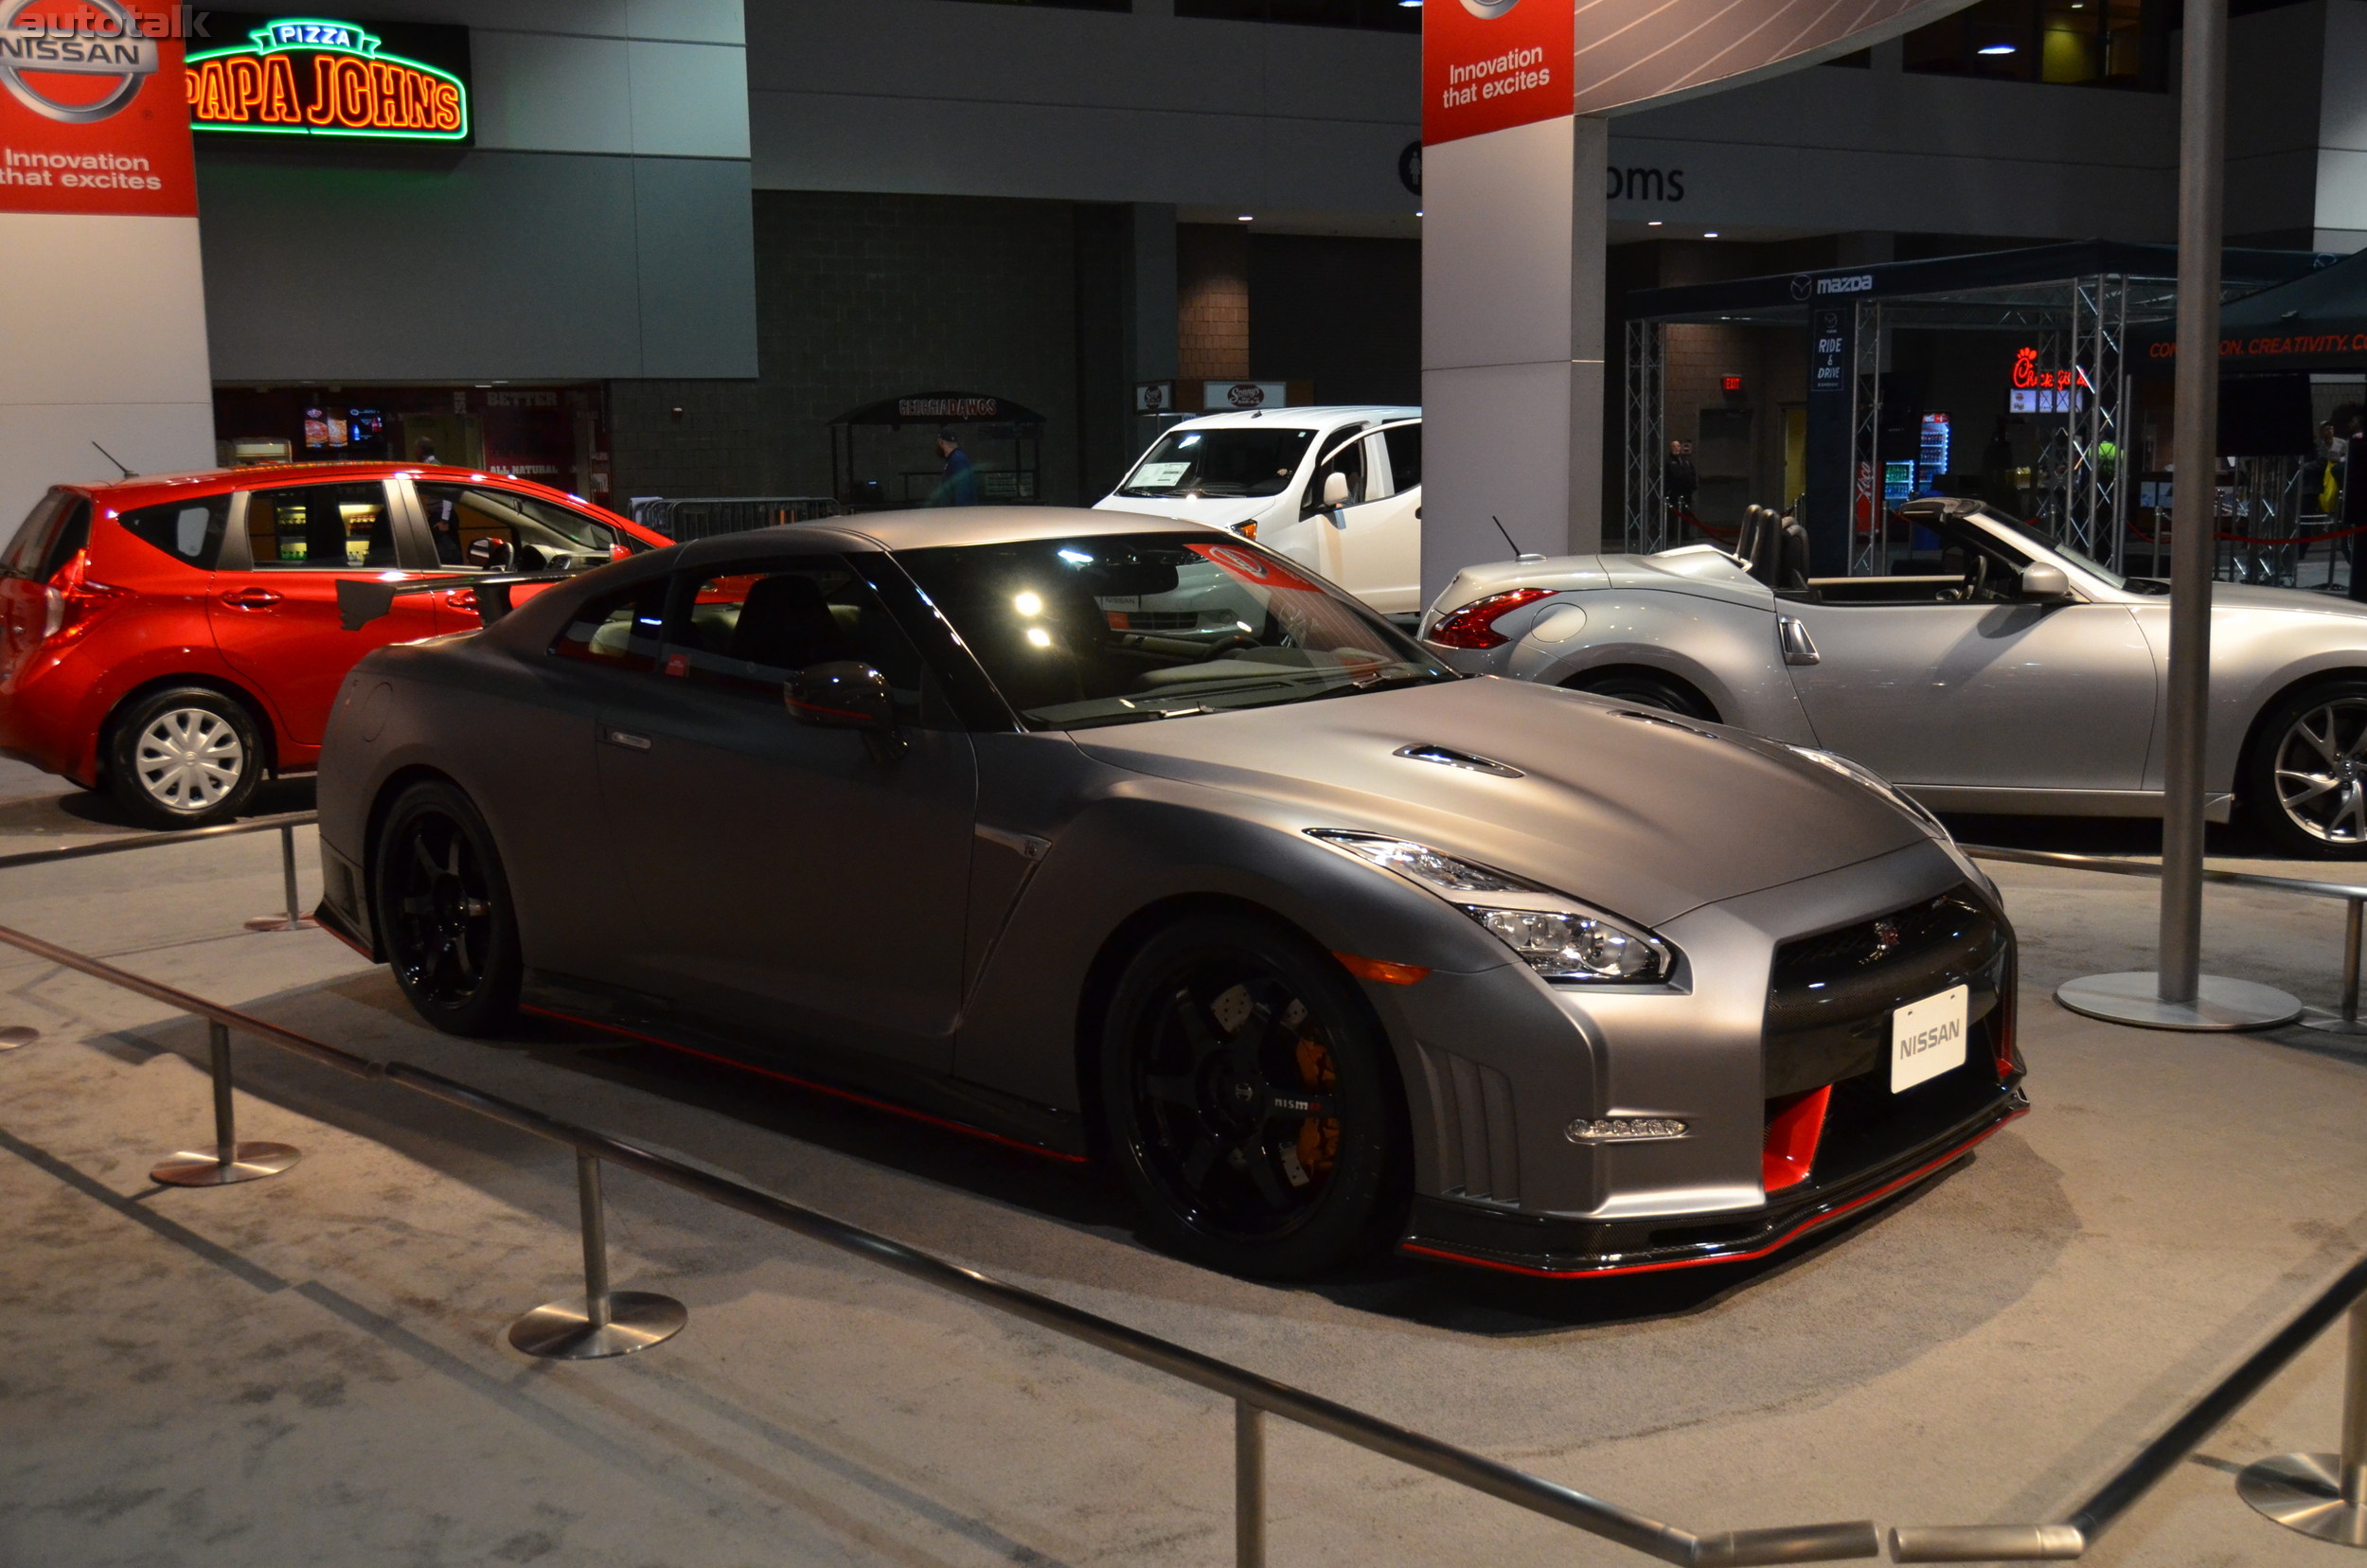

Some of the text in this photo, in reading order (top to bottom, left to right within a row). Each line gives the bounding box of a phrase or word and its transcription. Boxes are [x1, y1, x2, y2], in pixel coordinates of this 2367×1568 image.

[280, 26, 351, 46] PIZZA
[0, 39, 140, 65] NISSAN
[1450, 46, 1543, 85] Innovation
[307, 54, 462, 131] JOHNS
[1442, 67, 1551, 109] that excites
[6, 148, 150, 171] Innovation
[0, 168, 162, 190] that excites
[1818, 337, 1842, 353] RIDE
[2248, 334, 2350, 355] CREATIVITY.
[1826, 354, 1833, 366] &
[1817, 366, 1841, 379] DRIVE
[1725, 378, 1740, 390] EXIT
[487, 391, 559, 407] BETTER
[489, 465, 509, 474] ALL
[511, 465, 559, 474] NATURAL
[1899, 1018, 1960, 1060] NISSAN
